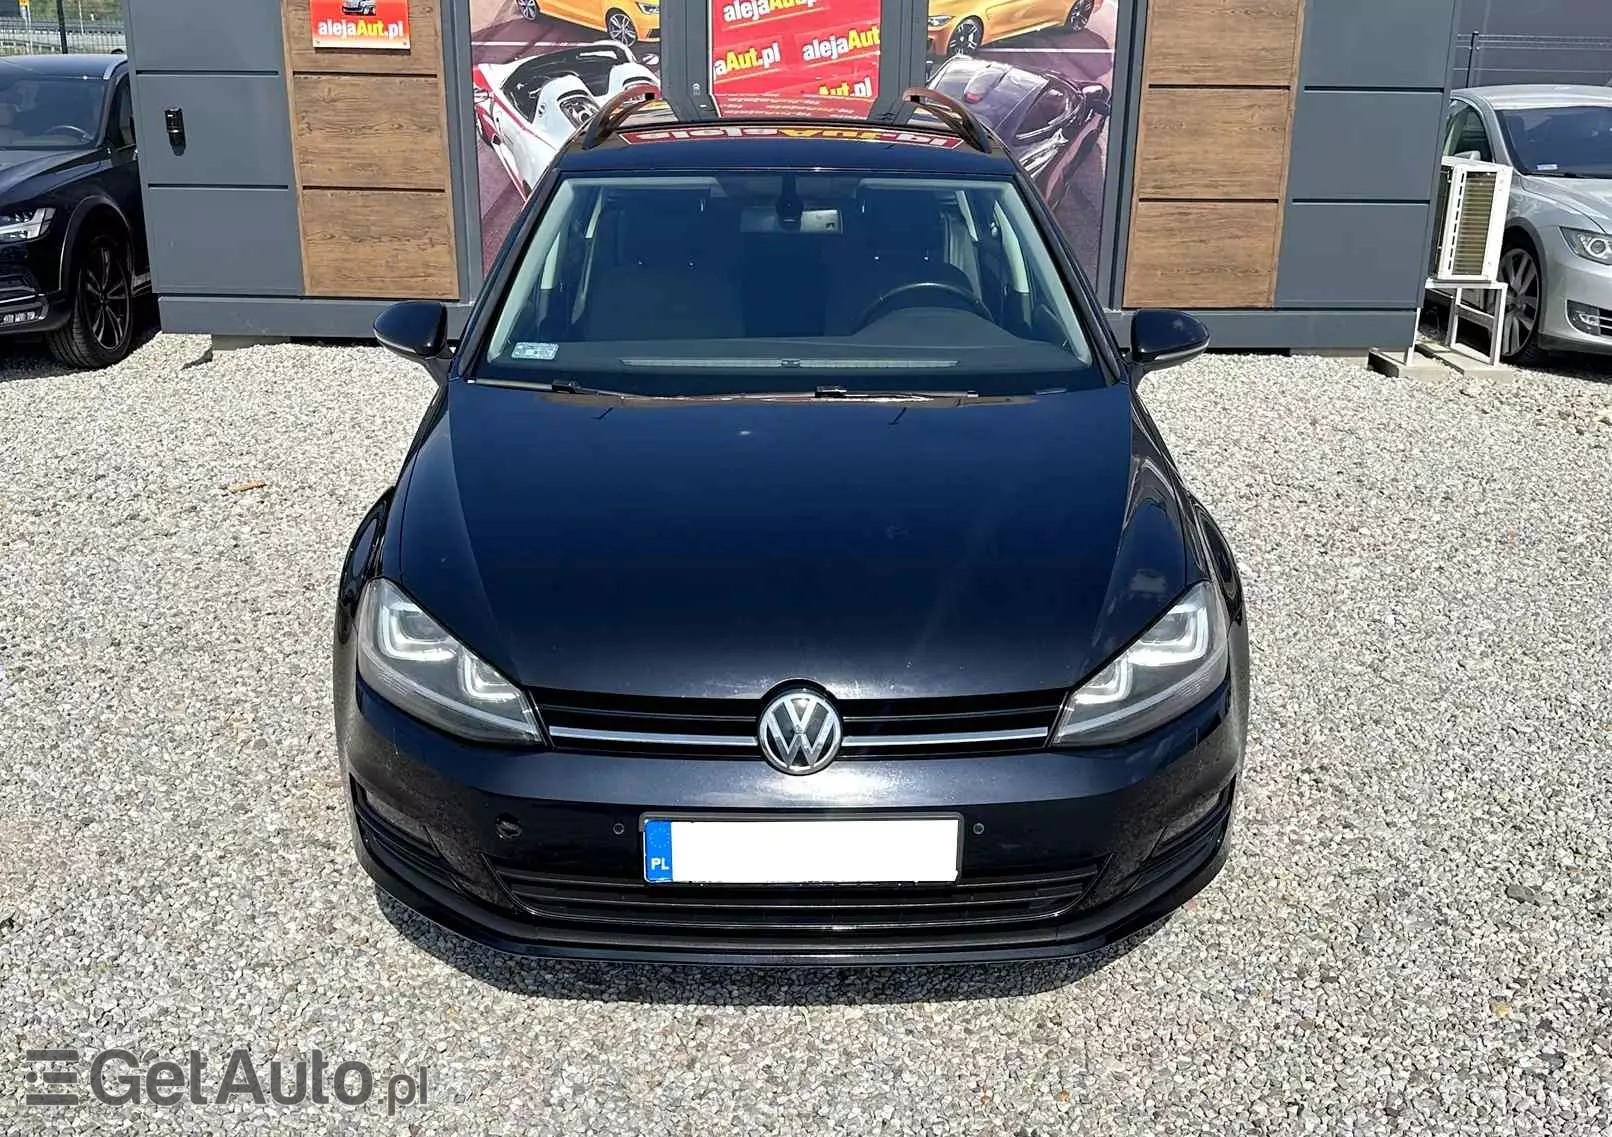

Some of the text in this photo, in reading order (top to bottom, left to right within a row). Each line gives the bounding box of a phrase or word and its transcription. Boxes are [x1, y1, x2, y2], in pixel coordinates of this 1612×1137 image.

[317, 19, 404, 40] alejaAut.pl
[802, 25, 880, 60] alejaAut
[763, 693, 838, 771] VW
[650, 857, 670, 871] PL
